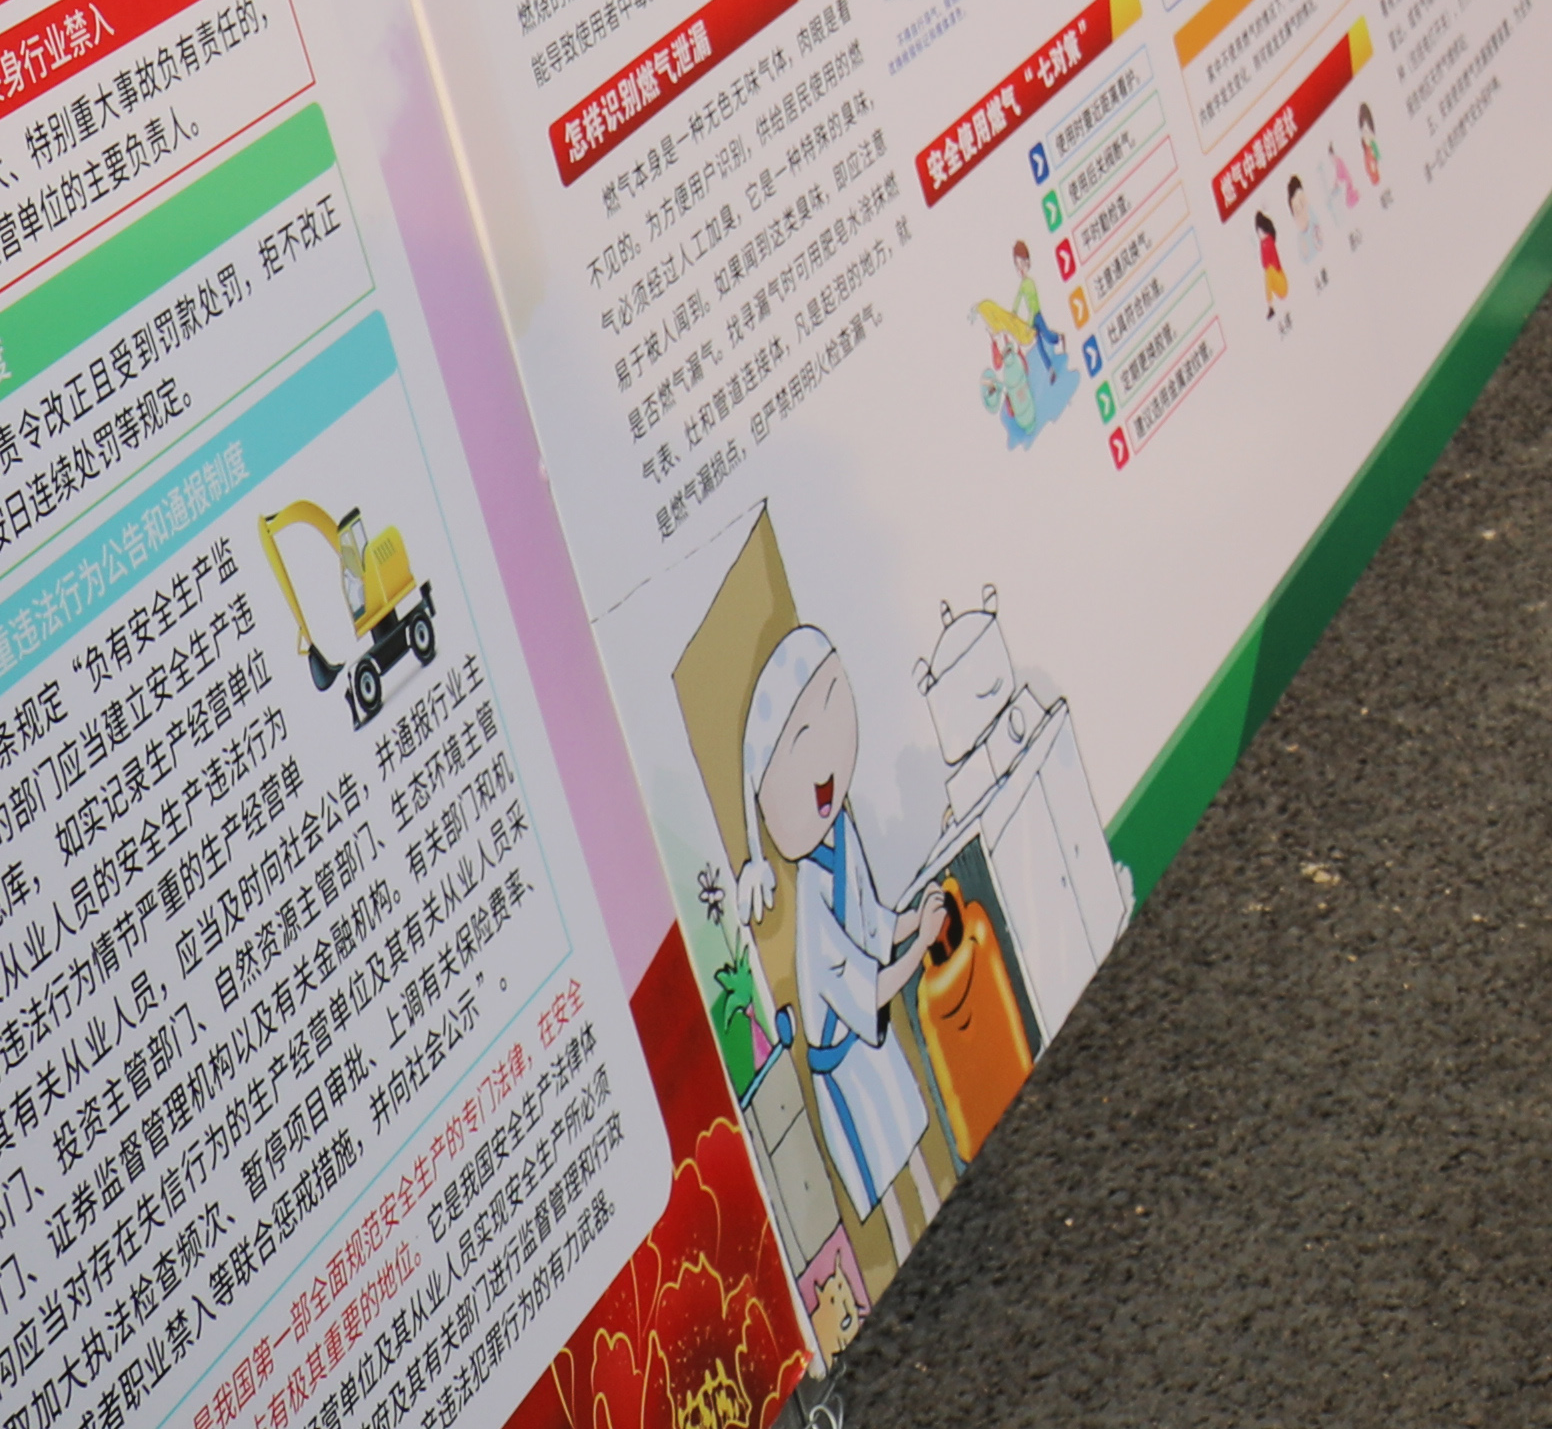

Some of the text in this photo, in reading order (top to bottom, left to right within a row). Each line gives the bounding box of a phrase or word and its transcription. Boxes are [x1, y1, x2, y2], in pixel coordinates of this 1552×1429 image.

[558, 16, 715, 166] 怎样识别燃气泄漏
[583, 37, 866, 293] 不见的。为方便用户识别，供给居民使用的燃
[596, 82, 877, 344] 气必须经过人工加臭，它是一种特殊的臭味，
[610, 126, 889, 395] 易于被人闻到。如果闻到这类臭味，即应注意
[0, 642, 274, 928] 库，如实记录生产经营单位
